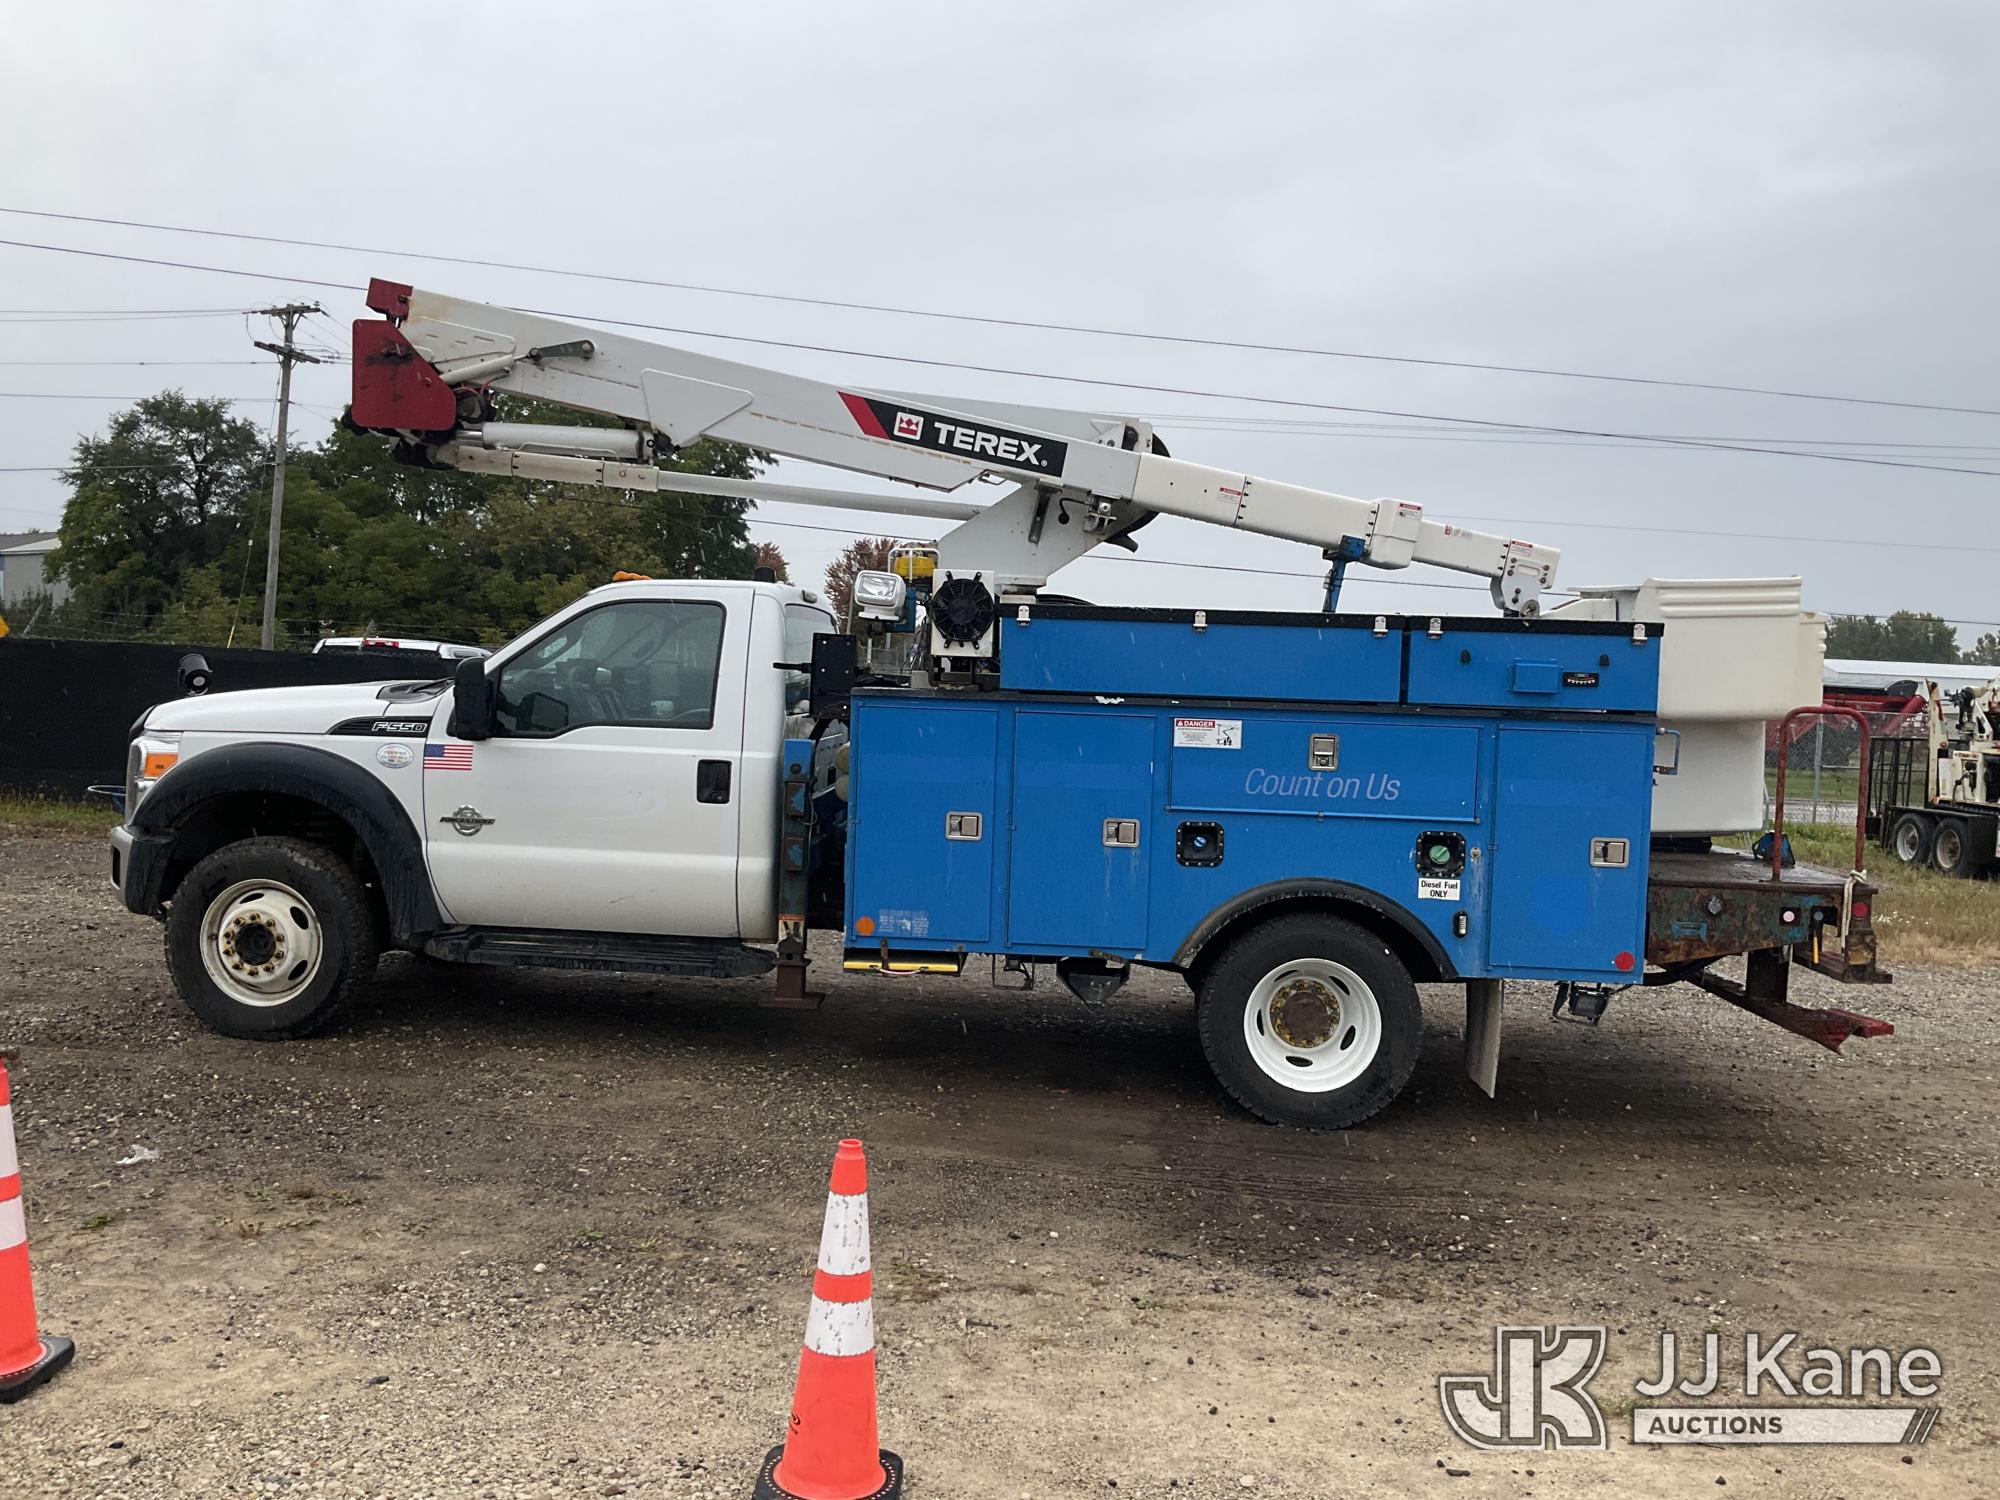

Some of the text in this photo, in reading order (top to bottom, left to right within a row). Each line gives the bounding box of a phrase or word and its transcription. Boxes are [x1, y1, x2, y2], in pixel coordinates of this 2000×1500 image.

[1244, 768, 1401, 800] Count on Us
[1421, 880, 1441, 888] Diesel
